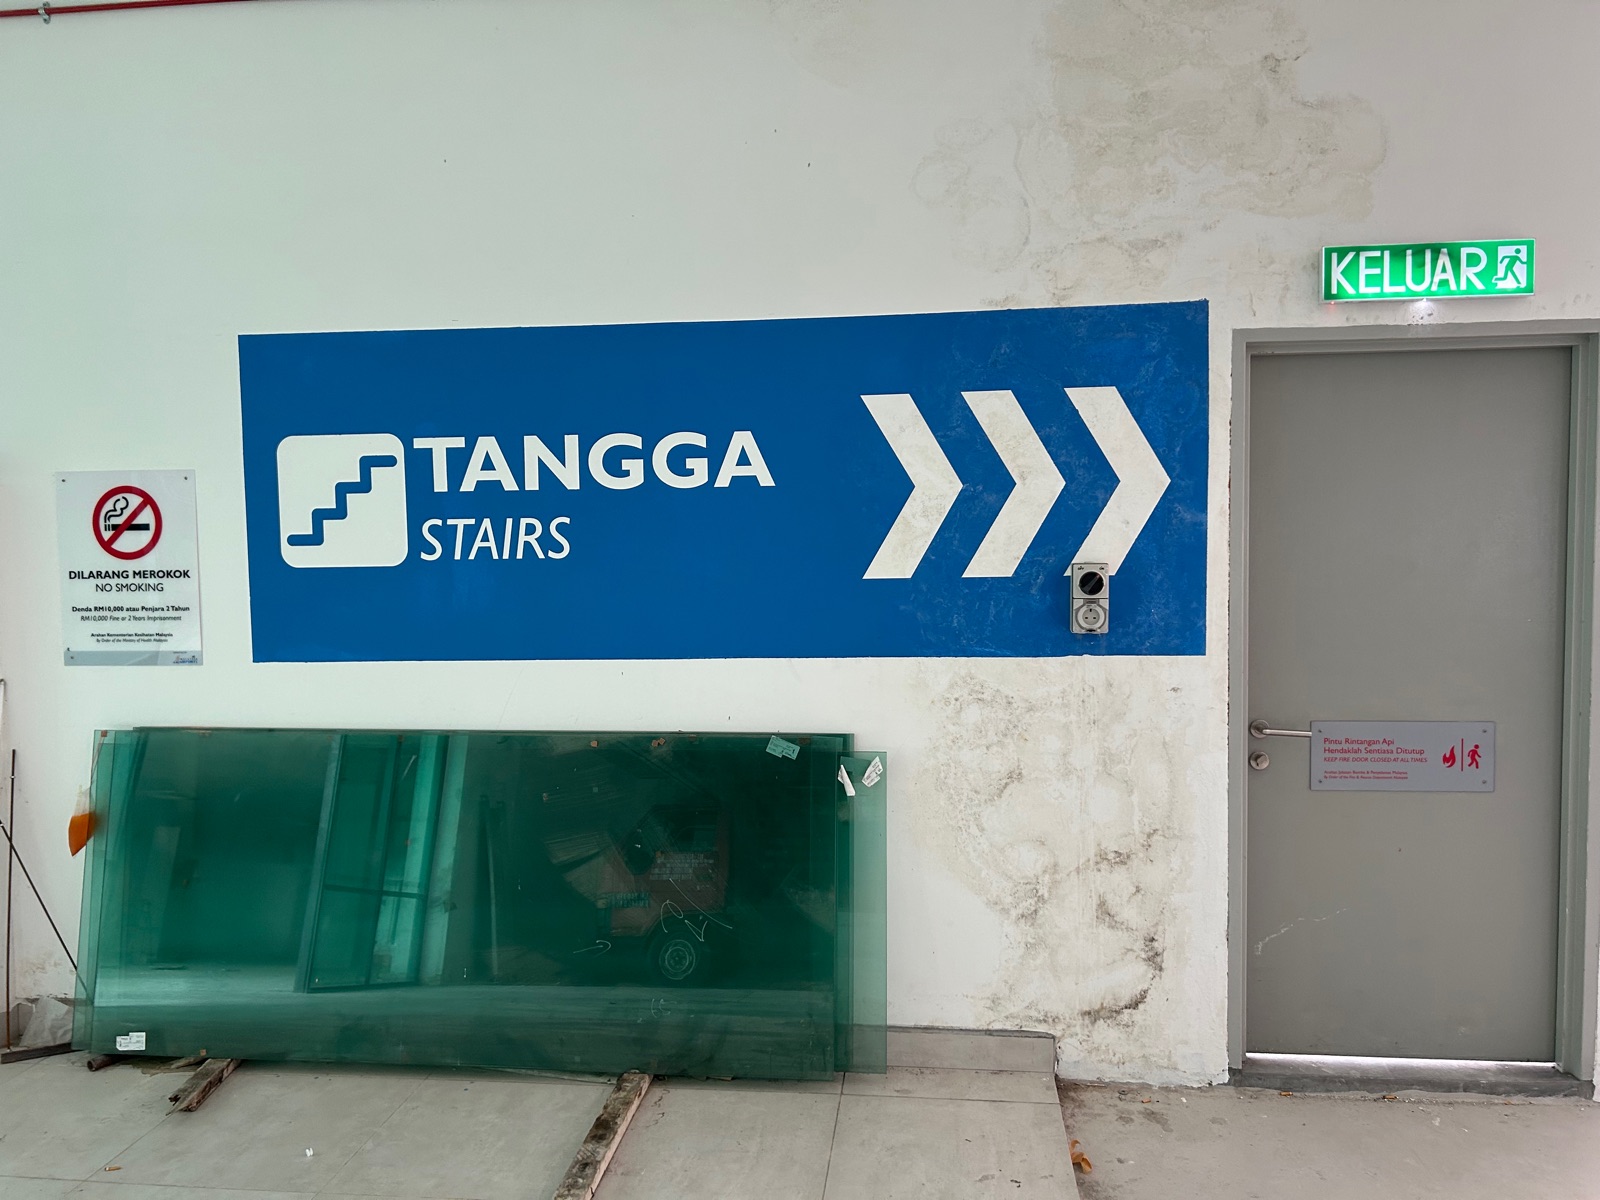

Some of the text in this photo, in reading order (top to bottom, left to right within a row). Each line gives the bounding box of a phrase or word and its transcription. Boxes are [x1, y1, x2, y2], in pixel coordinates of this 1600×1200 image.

[1331, 247, 1488, 295] KELUAR
[413, 430, 776, 493] TANGGA
[420, 516, 571, 561] STAIRS
[68, 569, 191, 580] DILARANG MEROKOK
[95, 582, 164, 593] NO SMOKING
[1344, 738, 1380, 747] Rintangan
[1381, 738, 1395, 747] Api
[1396, 747, 1425, 756] Ditutup
